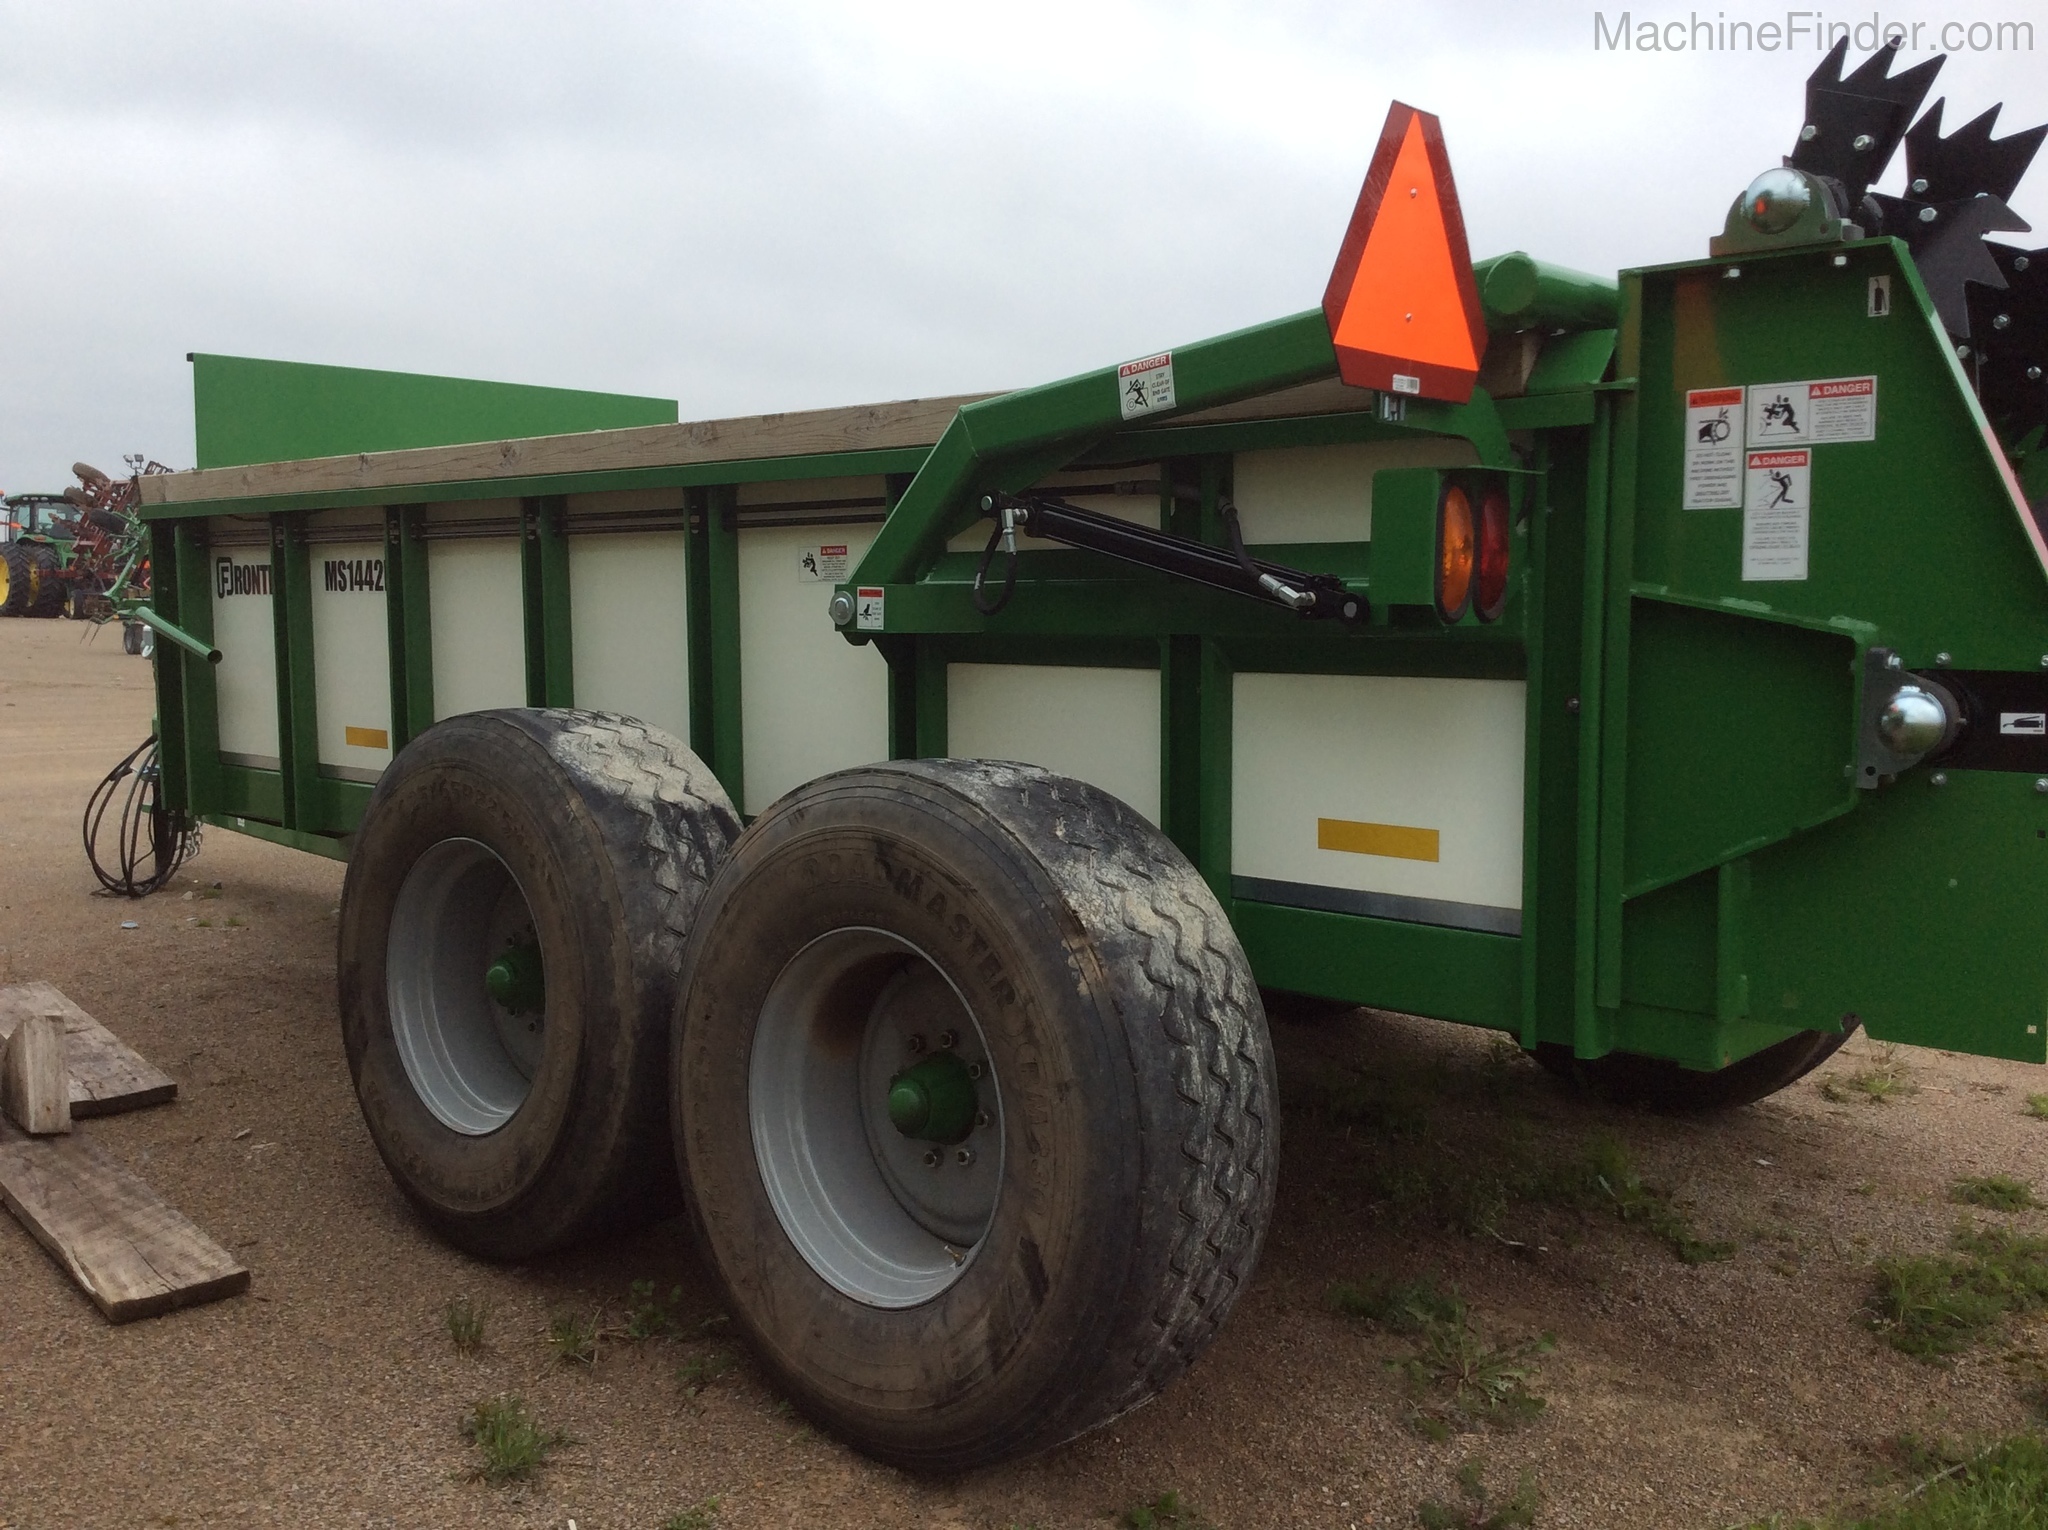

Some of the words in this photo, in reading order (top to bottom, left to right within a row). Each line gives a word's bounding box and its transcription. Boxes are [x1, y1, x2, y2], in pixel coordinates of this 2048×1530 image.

[1131, 356, 1167, 373] DANGER
[1823, 383, 1871, 395] DANGER
[1762, 454, 1806, 466] DANGER
[324, 559, 387, 592] MS1442
